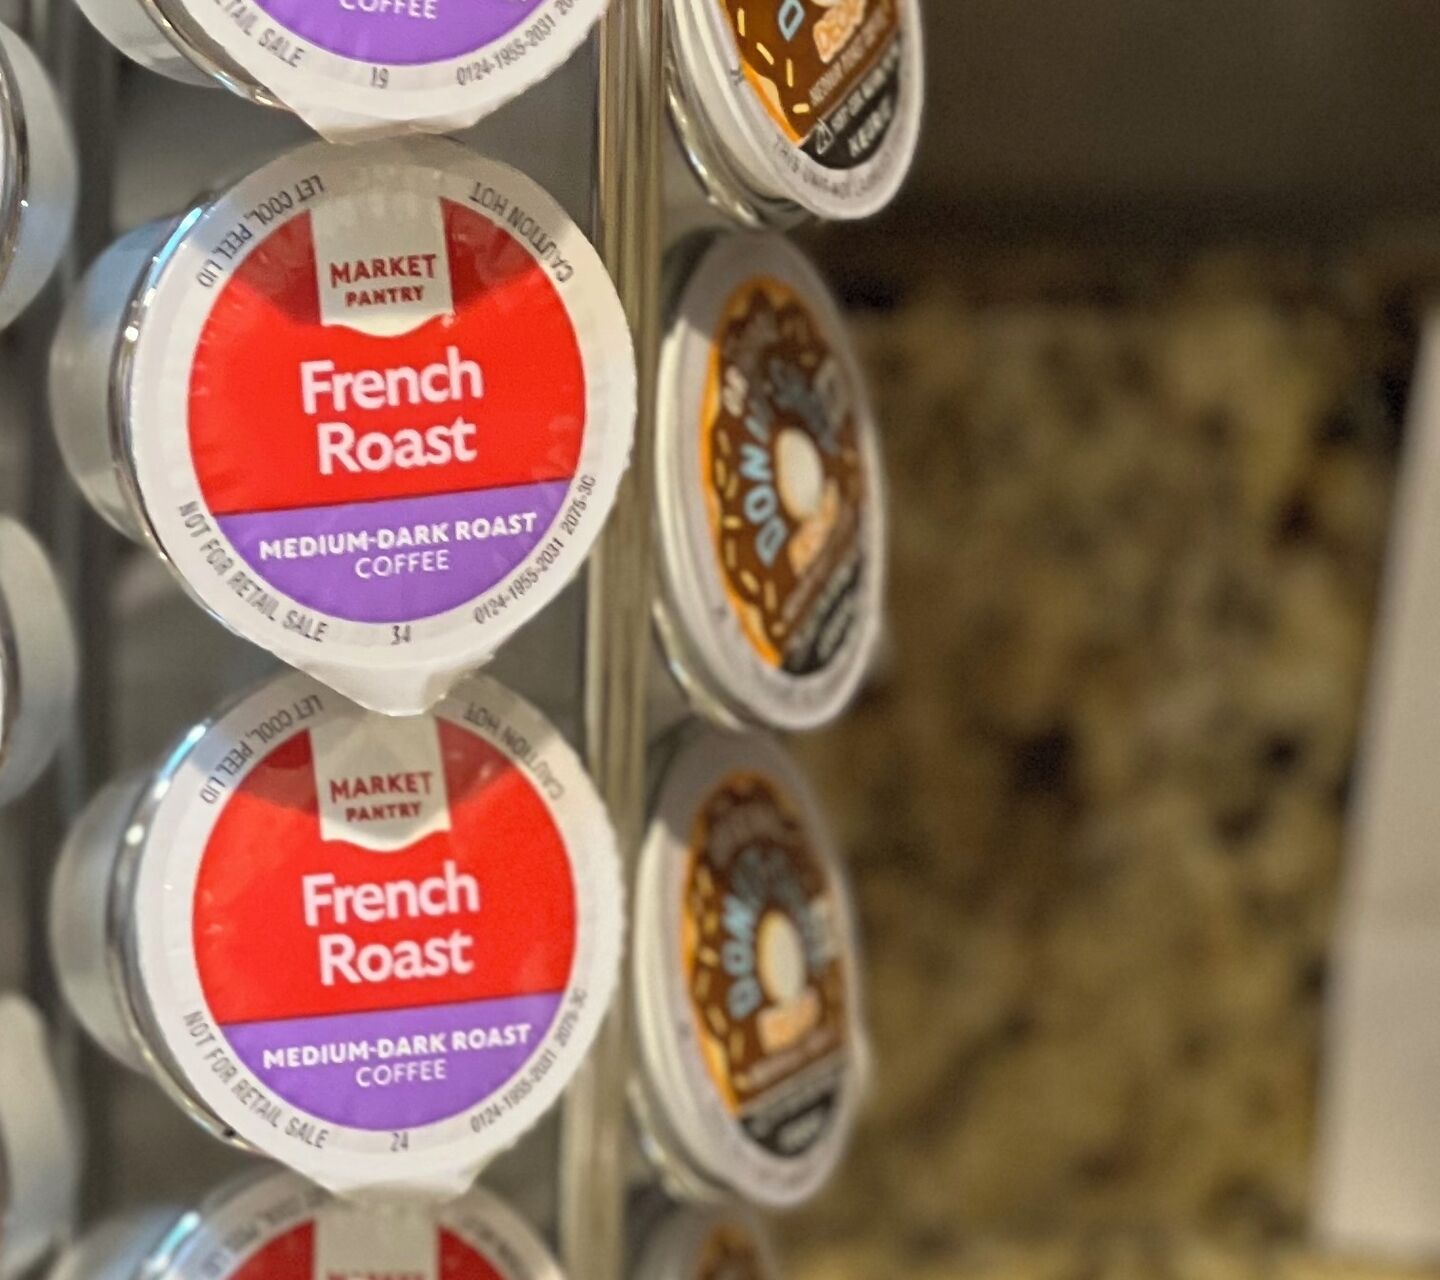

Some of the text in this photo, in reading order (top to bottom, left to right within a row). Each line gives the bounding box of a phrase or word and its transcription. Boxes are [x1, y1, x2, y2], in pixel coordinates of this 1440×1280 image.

[258, 28, 305, 68] SALE
[297, 174, 325, 203] LET
[213, 227, 253, 262] PEEL
[469, 181, 574, 284] CAUTION HOT
[330, 253, 437, 288] MARKET
[345, 285, 425, 308] PANTRY
[300, 346, 484, 415] French
[317, 416, 478, 476] Roast
[259, 513, 537, 561] MEDIUM-DARK ROAST
[178, 501, 328, 643] NOT FOR RETAIL SALE
[355, 549, 450, 579] COFFEE
[294, 694, 325, 720] LET
[222, 739, 255, 778] PEEL
[462, 701, 566, 801] CAUTION HOT
[329, 771, 433, 803] MARKET
[345, 801, 423, 822] PANTRY
[302, 861, 480, 928] French
[318, 930, 475, 986] Roast
[262, 1024, 532, 1070] MEDIUM-DARK ROAST
[183, 1010, 329, 1149] NOT FOR RETAIL SALE
[356, 1059, 447, 1088] COFFEE
